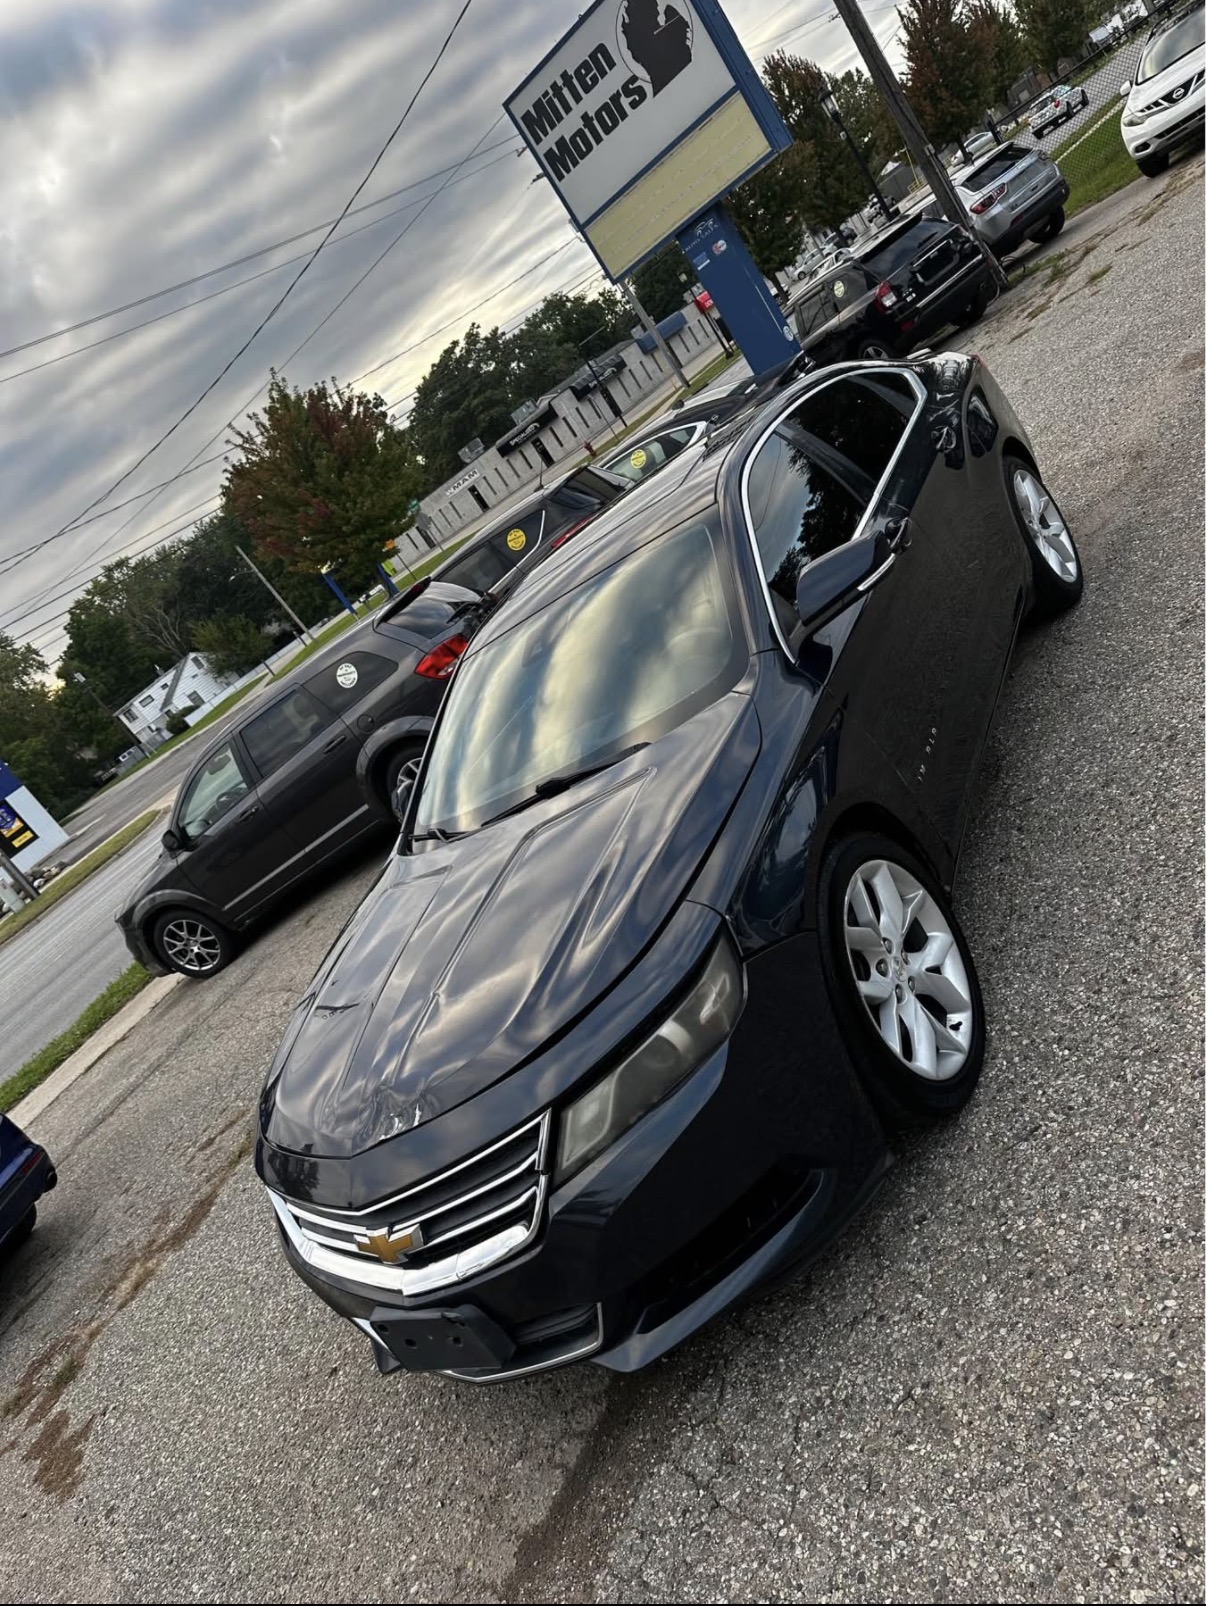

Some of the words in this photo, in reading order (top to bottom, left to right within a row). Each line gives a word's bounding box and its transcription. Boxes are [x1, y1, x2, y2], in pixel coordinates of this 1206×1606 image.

[520, 42, 617, 146] Mitten
[543, 74, 648, 183] Motors
[452, 470, 478, 491] MAM
